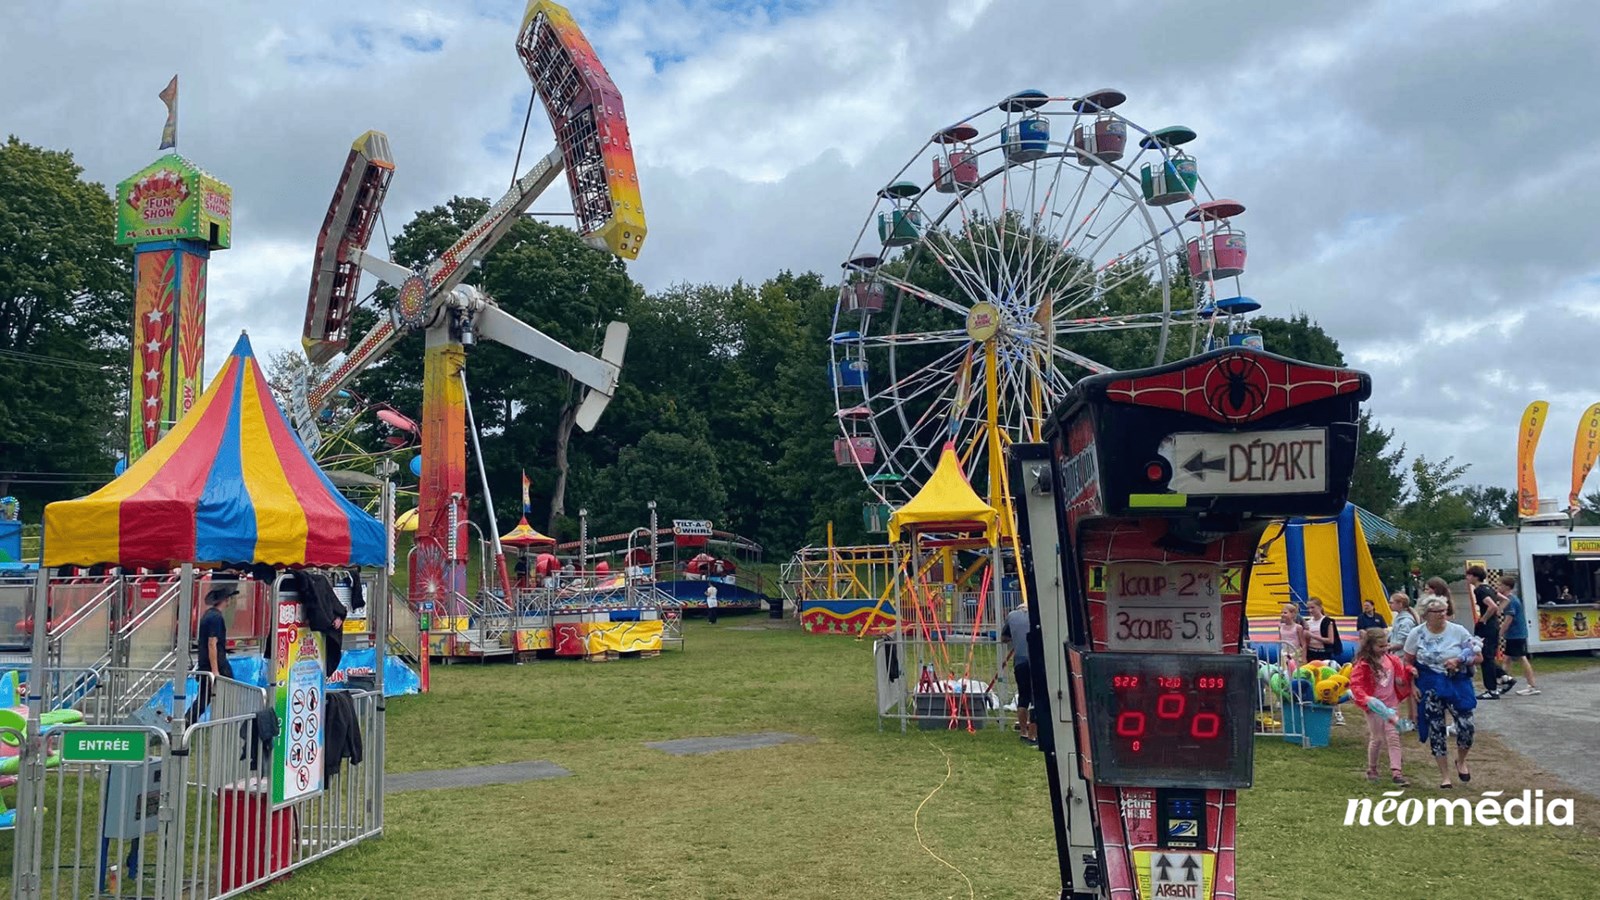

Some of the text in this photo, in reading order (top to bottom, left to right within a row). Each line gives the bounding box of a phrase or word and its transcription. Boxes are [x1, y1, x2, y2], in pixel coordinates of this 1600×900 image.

[149, 198, 171, 208] FUN
[209, 193, 225, 206] FUN
[143, 208, 175, 219] SHOW
[205, 200, 229, 216] SHOW
[1229, 438, 1322, 482] DÉPART
[1158, 694, 1185, 718] 0
[1117, 712, 1145, 736] 0
[1191, 713, 1219, 737] 0
[78, 738, 130, 751] ENTRÉE
[1127, 799, 1151, 809] COIN
[1127, 809, 1151, 819] HERE
[1156, 883, 1198, 898] ARGENT
